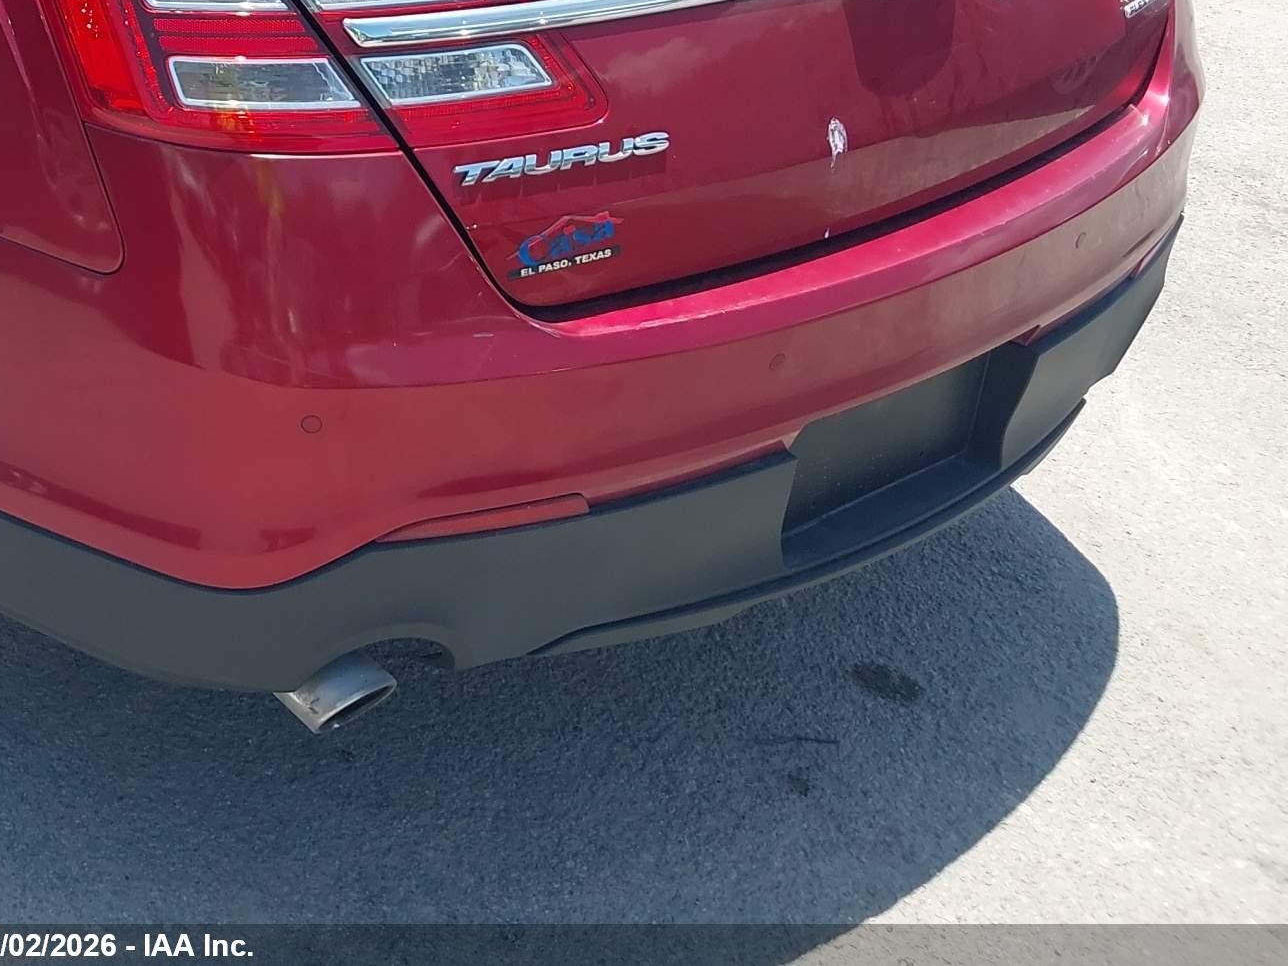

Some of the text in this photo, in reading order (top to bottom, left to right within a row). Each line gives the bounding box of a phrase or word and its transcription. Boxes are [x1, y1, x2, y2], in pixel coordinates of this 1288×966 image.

[453, 132, 670, 186] TAURUS
[520, 268, 536, 278] EL
[574, 248, 612, 266] TEXAS
